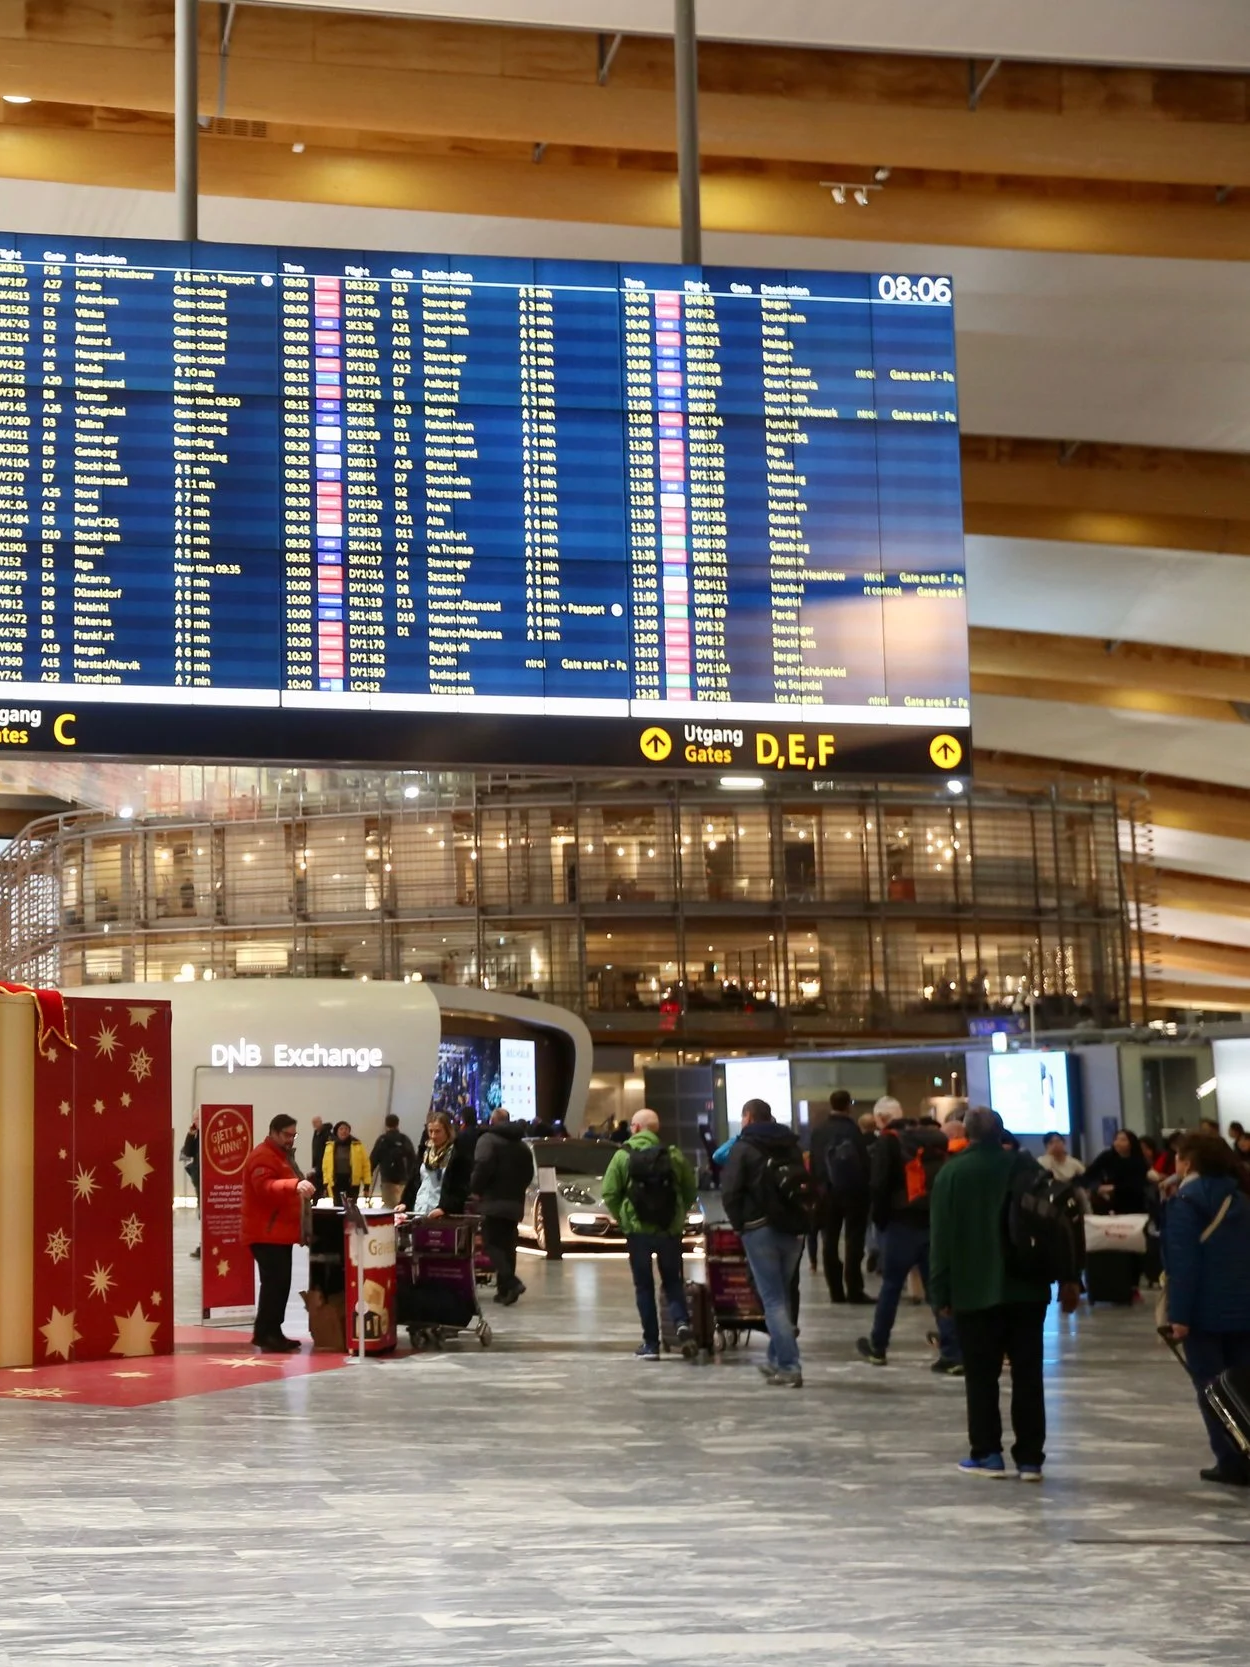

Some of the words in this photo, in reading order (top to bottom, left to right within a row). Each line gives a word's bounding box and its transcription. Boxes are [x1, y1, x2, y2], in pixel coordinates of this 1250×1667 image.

[173, 285, 197, 296] Gate
[196, 286, 228, 299] closing
[878, 275, 952, 302] 08:06
[74, 308, 105, 319] Vilnius
[173, 312, 197, 323] Gate
[196, 313, 228, 326] closing
[283, 344, 310, 356] 09:05
[423, 351, 468, 365] Stavanger
[529, 355, 537, 366] 5
[536, 355, 555, 367] min
[74, 362, 104, 374] Molde
[183, 366, 198, 378] 10
[198, 367, 216, 378] min
[889, 369, 911, 381] Gate
[910, 371, 931, 382] area
[930, 371, 937, 382] F
[283, 371, 310, 383] 09:15
[423, 378, 460, 391] Aalborg
[529, 381, 538, 393] 5
[537, 382, 555, 394] min
[173, 395, 195, 406] New
[194, 395, 215, 406] time
[214, 396, 241, 407] 08:50
[74, 418, 105, 429] Tallinn
[173, 422, 197, 433] Gate
[196, 423, 228, 436] closing
[284, 427, 311, 438] 09:20
[424, 433, 475, 445] Amsterdam
[531, 436, 539, 447] 4
[539, 436, 557, 448] min
[74, 474, 129, 486] Kristiansand
[183, 477, 198, 490] 11
[198, 478, 216, 490] min
[74, 488, 100, 499] Stord
[183, 491, 192, 503] 7
[192, 492, 211, 503] min
[284, 496, 311, 507] 09:30
[426, 501, 452, 513] Praha
[533, 505, 541, 516] 4
[540, 505, 558, 516] min
[74, 558, 94, 571] Riga
[173, 562, 195, 574] New
[194, 562, 215, 574] time
[214, 563, 242, 575] 09:35
[632, 563, 658, 575] 11:40
[770, 568, 847, 583] London/Heathrow
[899, 571, 921, 584] Gate
[920, 574, 941, 585] area
[940, 573, 947, 585] F
[285, 566, 312, 577] 10:00
[427, 571, 466, 583] Szczecin
[534, 574, 542, 586] 5
[542, 574, 560, 586] min
[73, 601, 110, 613] Helsinki
[183, 604, 192, 616] 5
[192, 605, 211, 616] min
[286, 594, 312, 606] 10:00
[427, 599, 502, 612] London/Stansted
[535, 601, 543, 613] 6
[543, 602, 561, 614] min
[567, 602, 605, 616] Passport
[73, 658, 141, 671] Harstad/Narvik
[183, 660, 192, 672] 6
[192, 661, 211, 672] min
[73, 672, 122, 684] Trondheim
[183, 674, 192, 686] 7
[192, 675, 211, 686] min
[53, 713, 76, 746] C
[684, 724, 743, 747] Utgang
[684, 745, 732, 763] Gates
[756, 732, 835, 770] D,E,F
[211, 1037, 262, 1074] DNB
[274, 1043, 383, 1073] Exchange
[211, 1126, 234, 1144] GJETT
